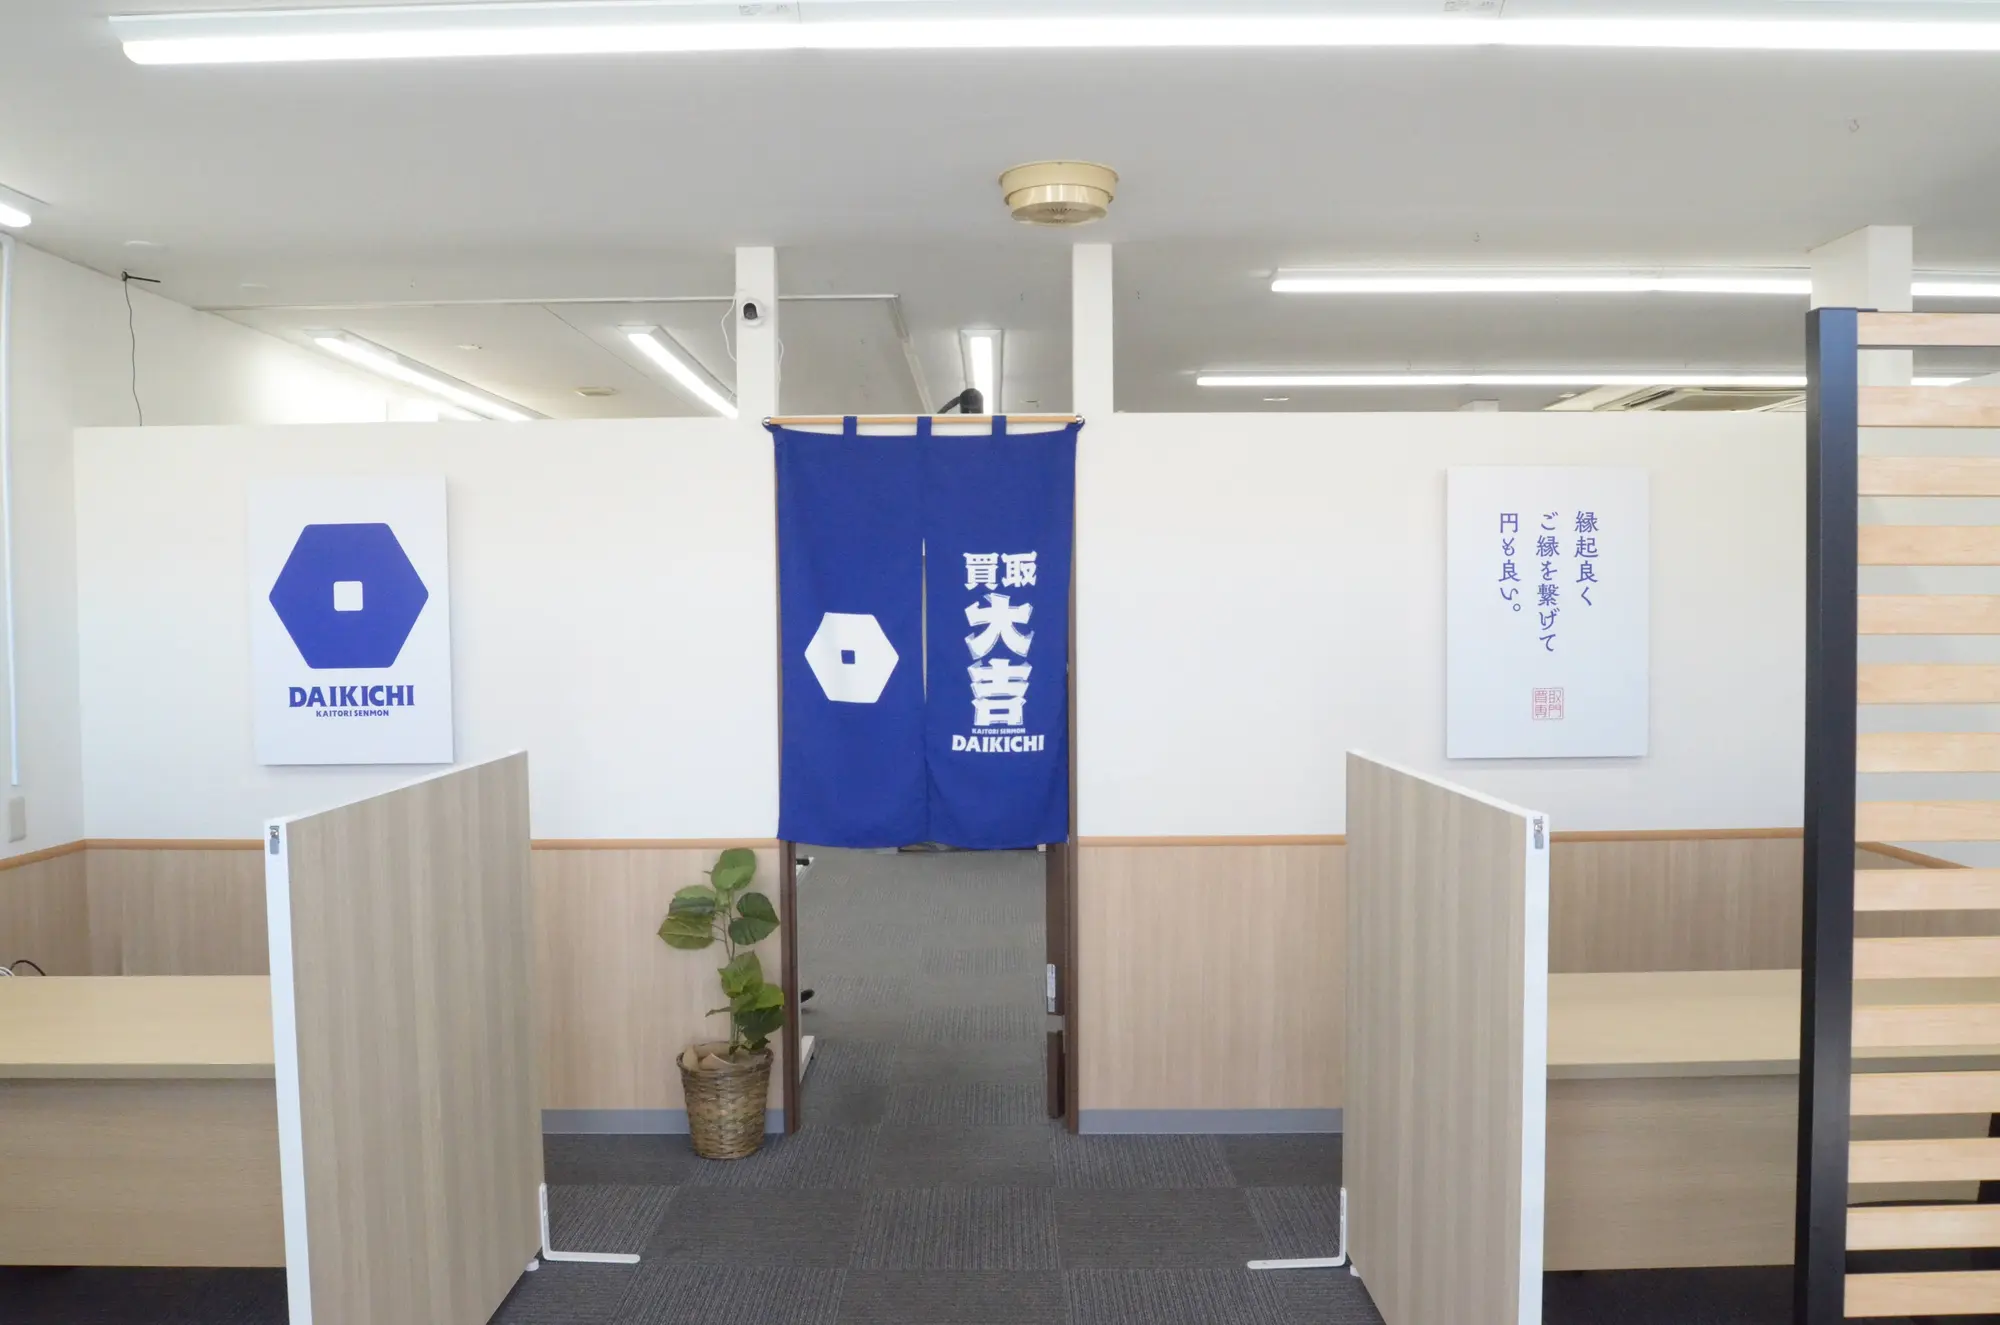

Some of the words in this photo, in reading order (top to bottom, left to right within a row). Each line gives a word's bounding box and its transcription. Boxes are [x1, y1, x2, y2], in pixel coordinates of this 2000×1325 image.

[962, 551, 1038, 591] 買取
[1498, 512, 1521, 613] 円も良い。
[1536, 511, 1561, 652] ご縁を繋げて
[1574, 511, 1599, 607] 縁起良く
[963, 592, 1035, 727] 大吉
[288, 684, 415, 709] DAIKICHI
[315, 709, 353, 718] KAITORI
[354, 708, 390, 717] SENMON
[951, 734, 1045, 753] DAIKICHI
